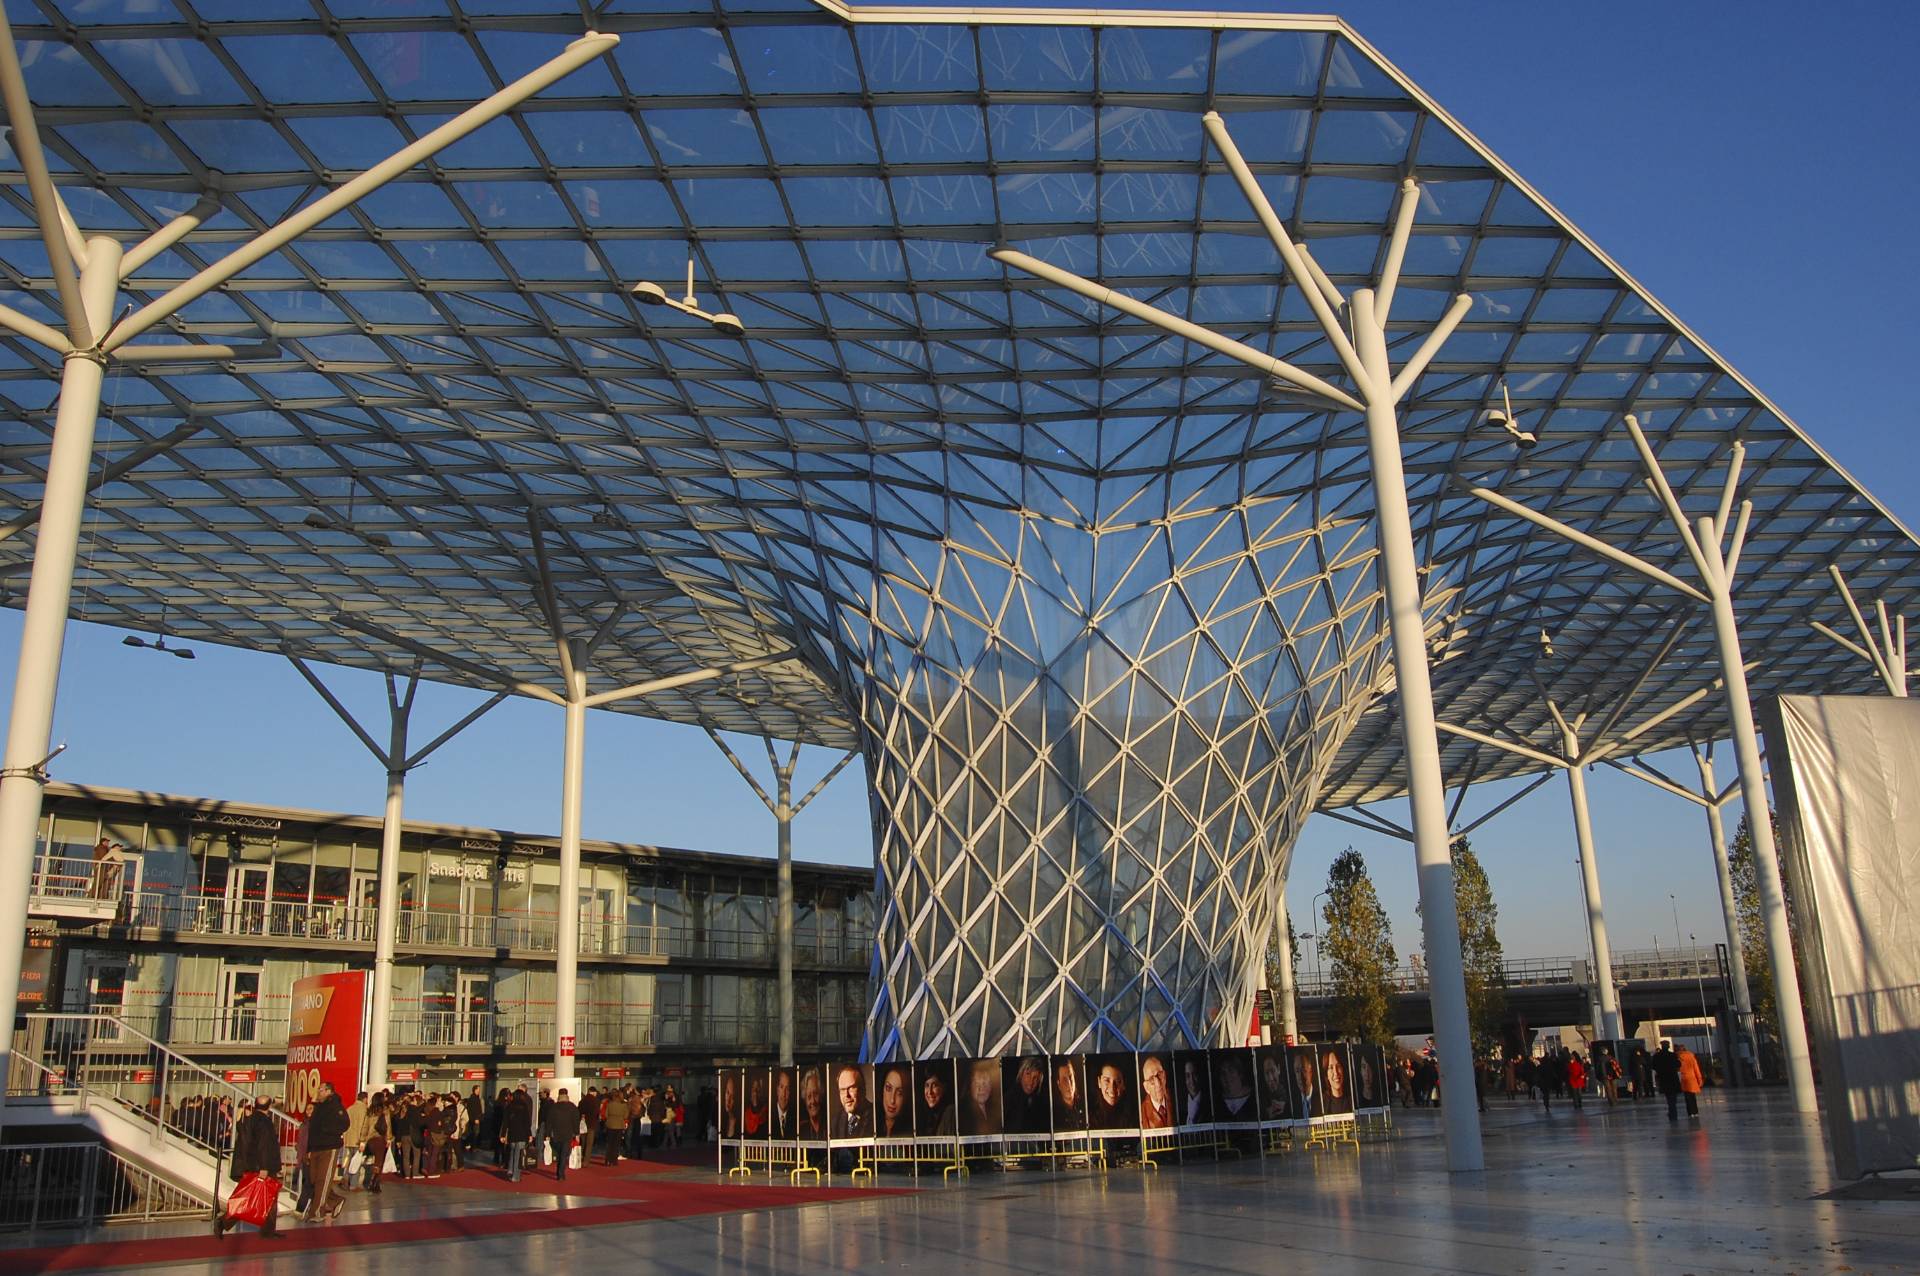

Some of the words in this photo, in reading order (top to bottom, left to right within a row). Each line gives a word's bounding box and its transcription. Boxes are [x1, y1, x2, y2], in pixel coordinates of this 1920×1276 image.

[430, 861, 471, 878] Snack
[474, 864, 483, 879] &
[324, 1043, 337, 1062] AL
